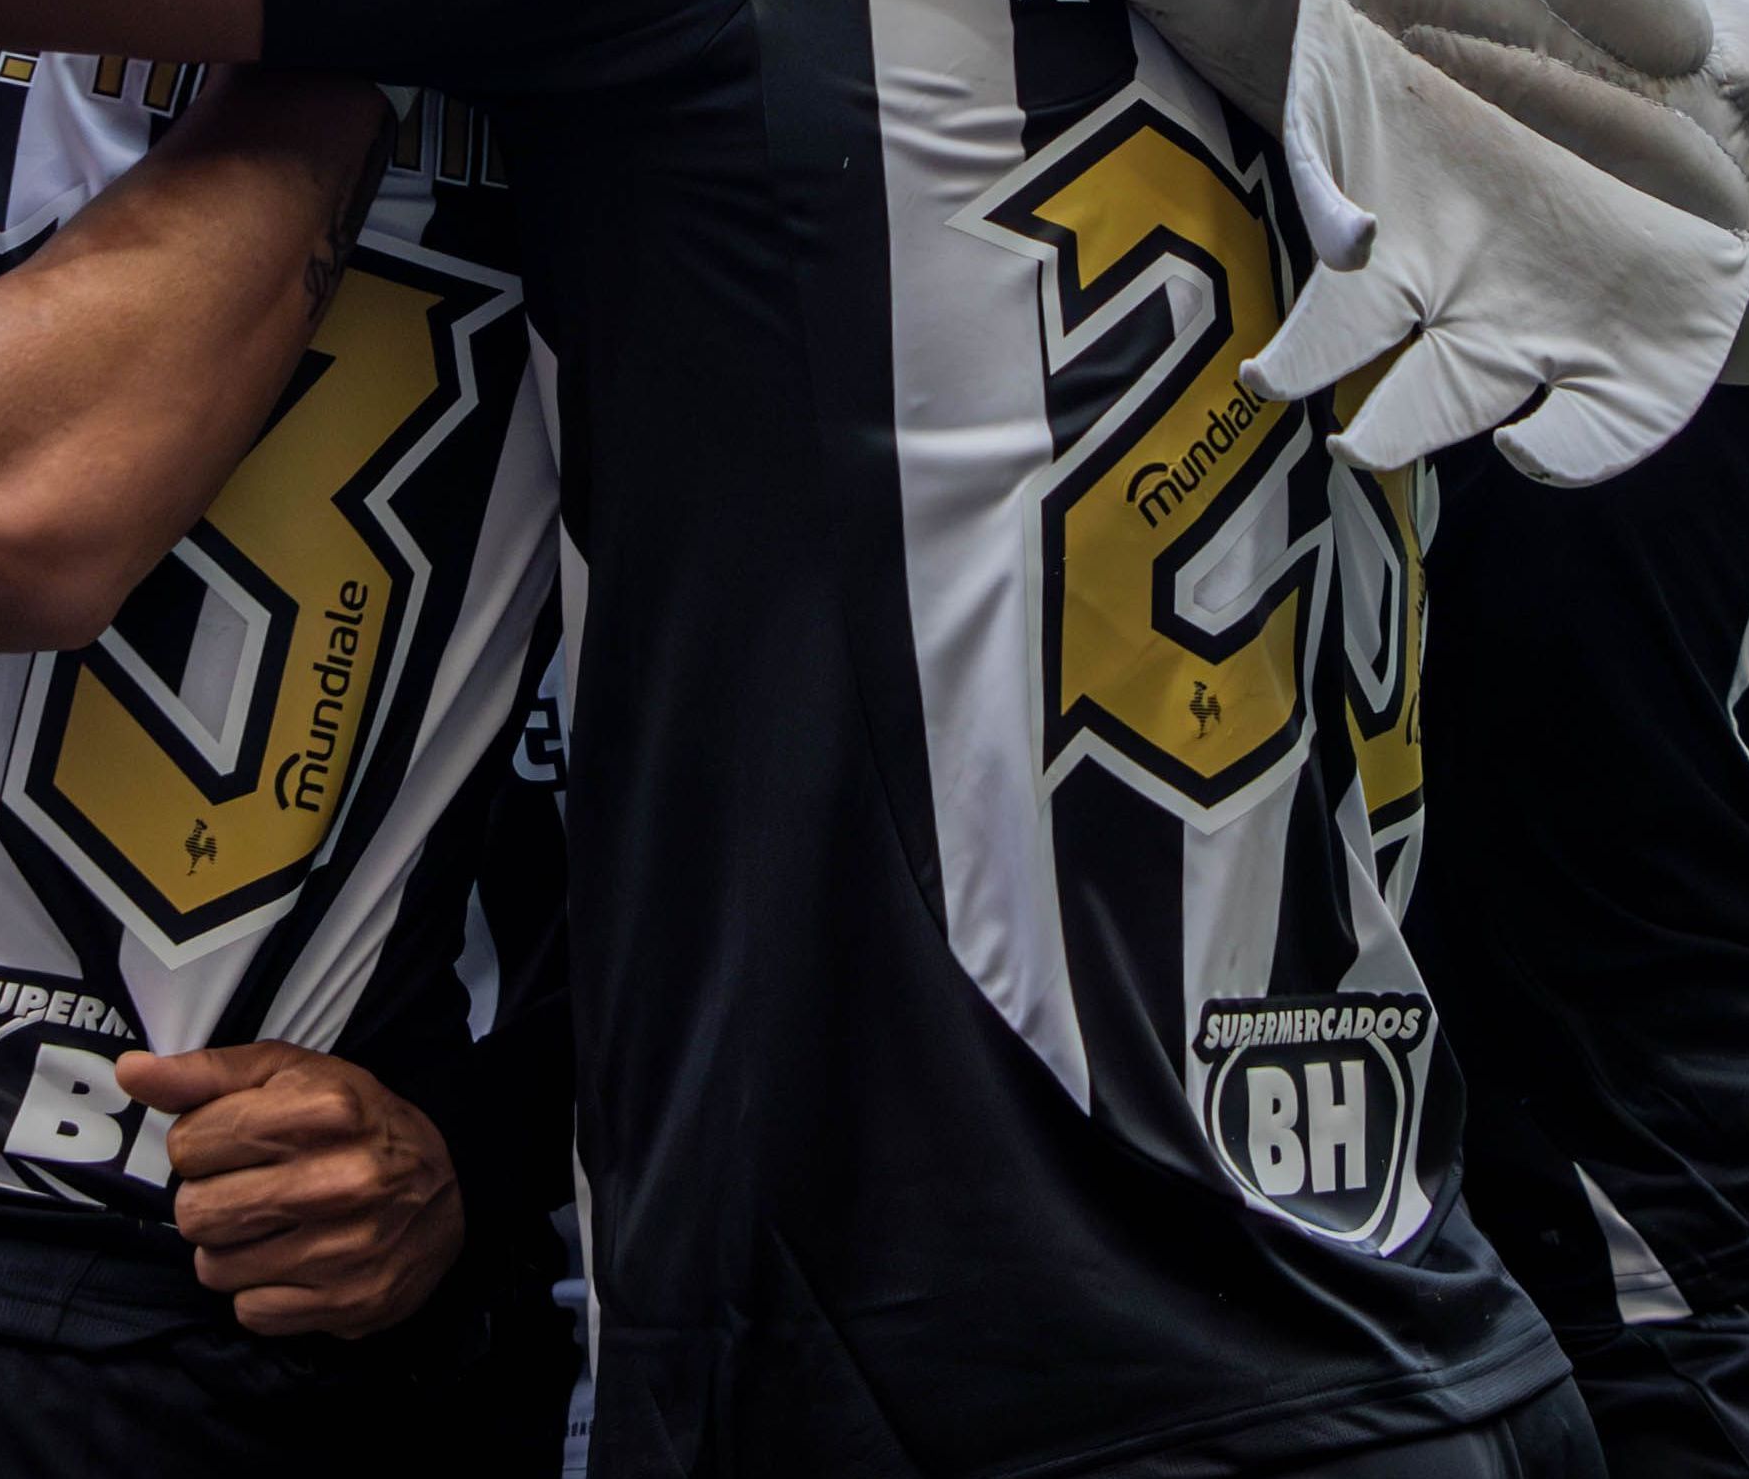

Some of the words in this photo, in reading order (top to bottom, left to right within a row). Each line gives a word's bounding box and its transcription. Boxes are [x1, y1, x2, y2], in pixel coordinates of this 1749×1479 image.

[1134, 379, 1268, 528] mundial
[290, 579, 370, 814] mundiale
[1204, 1007, 1422, 1049] SUPERMERCADOS
[1246, 1059, 1366, 1195] BH
